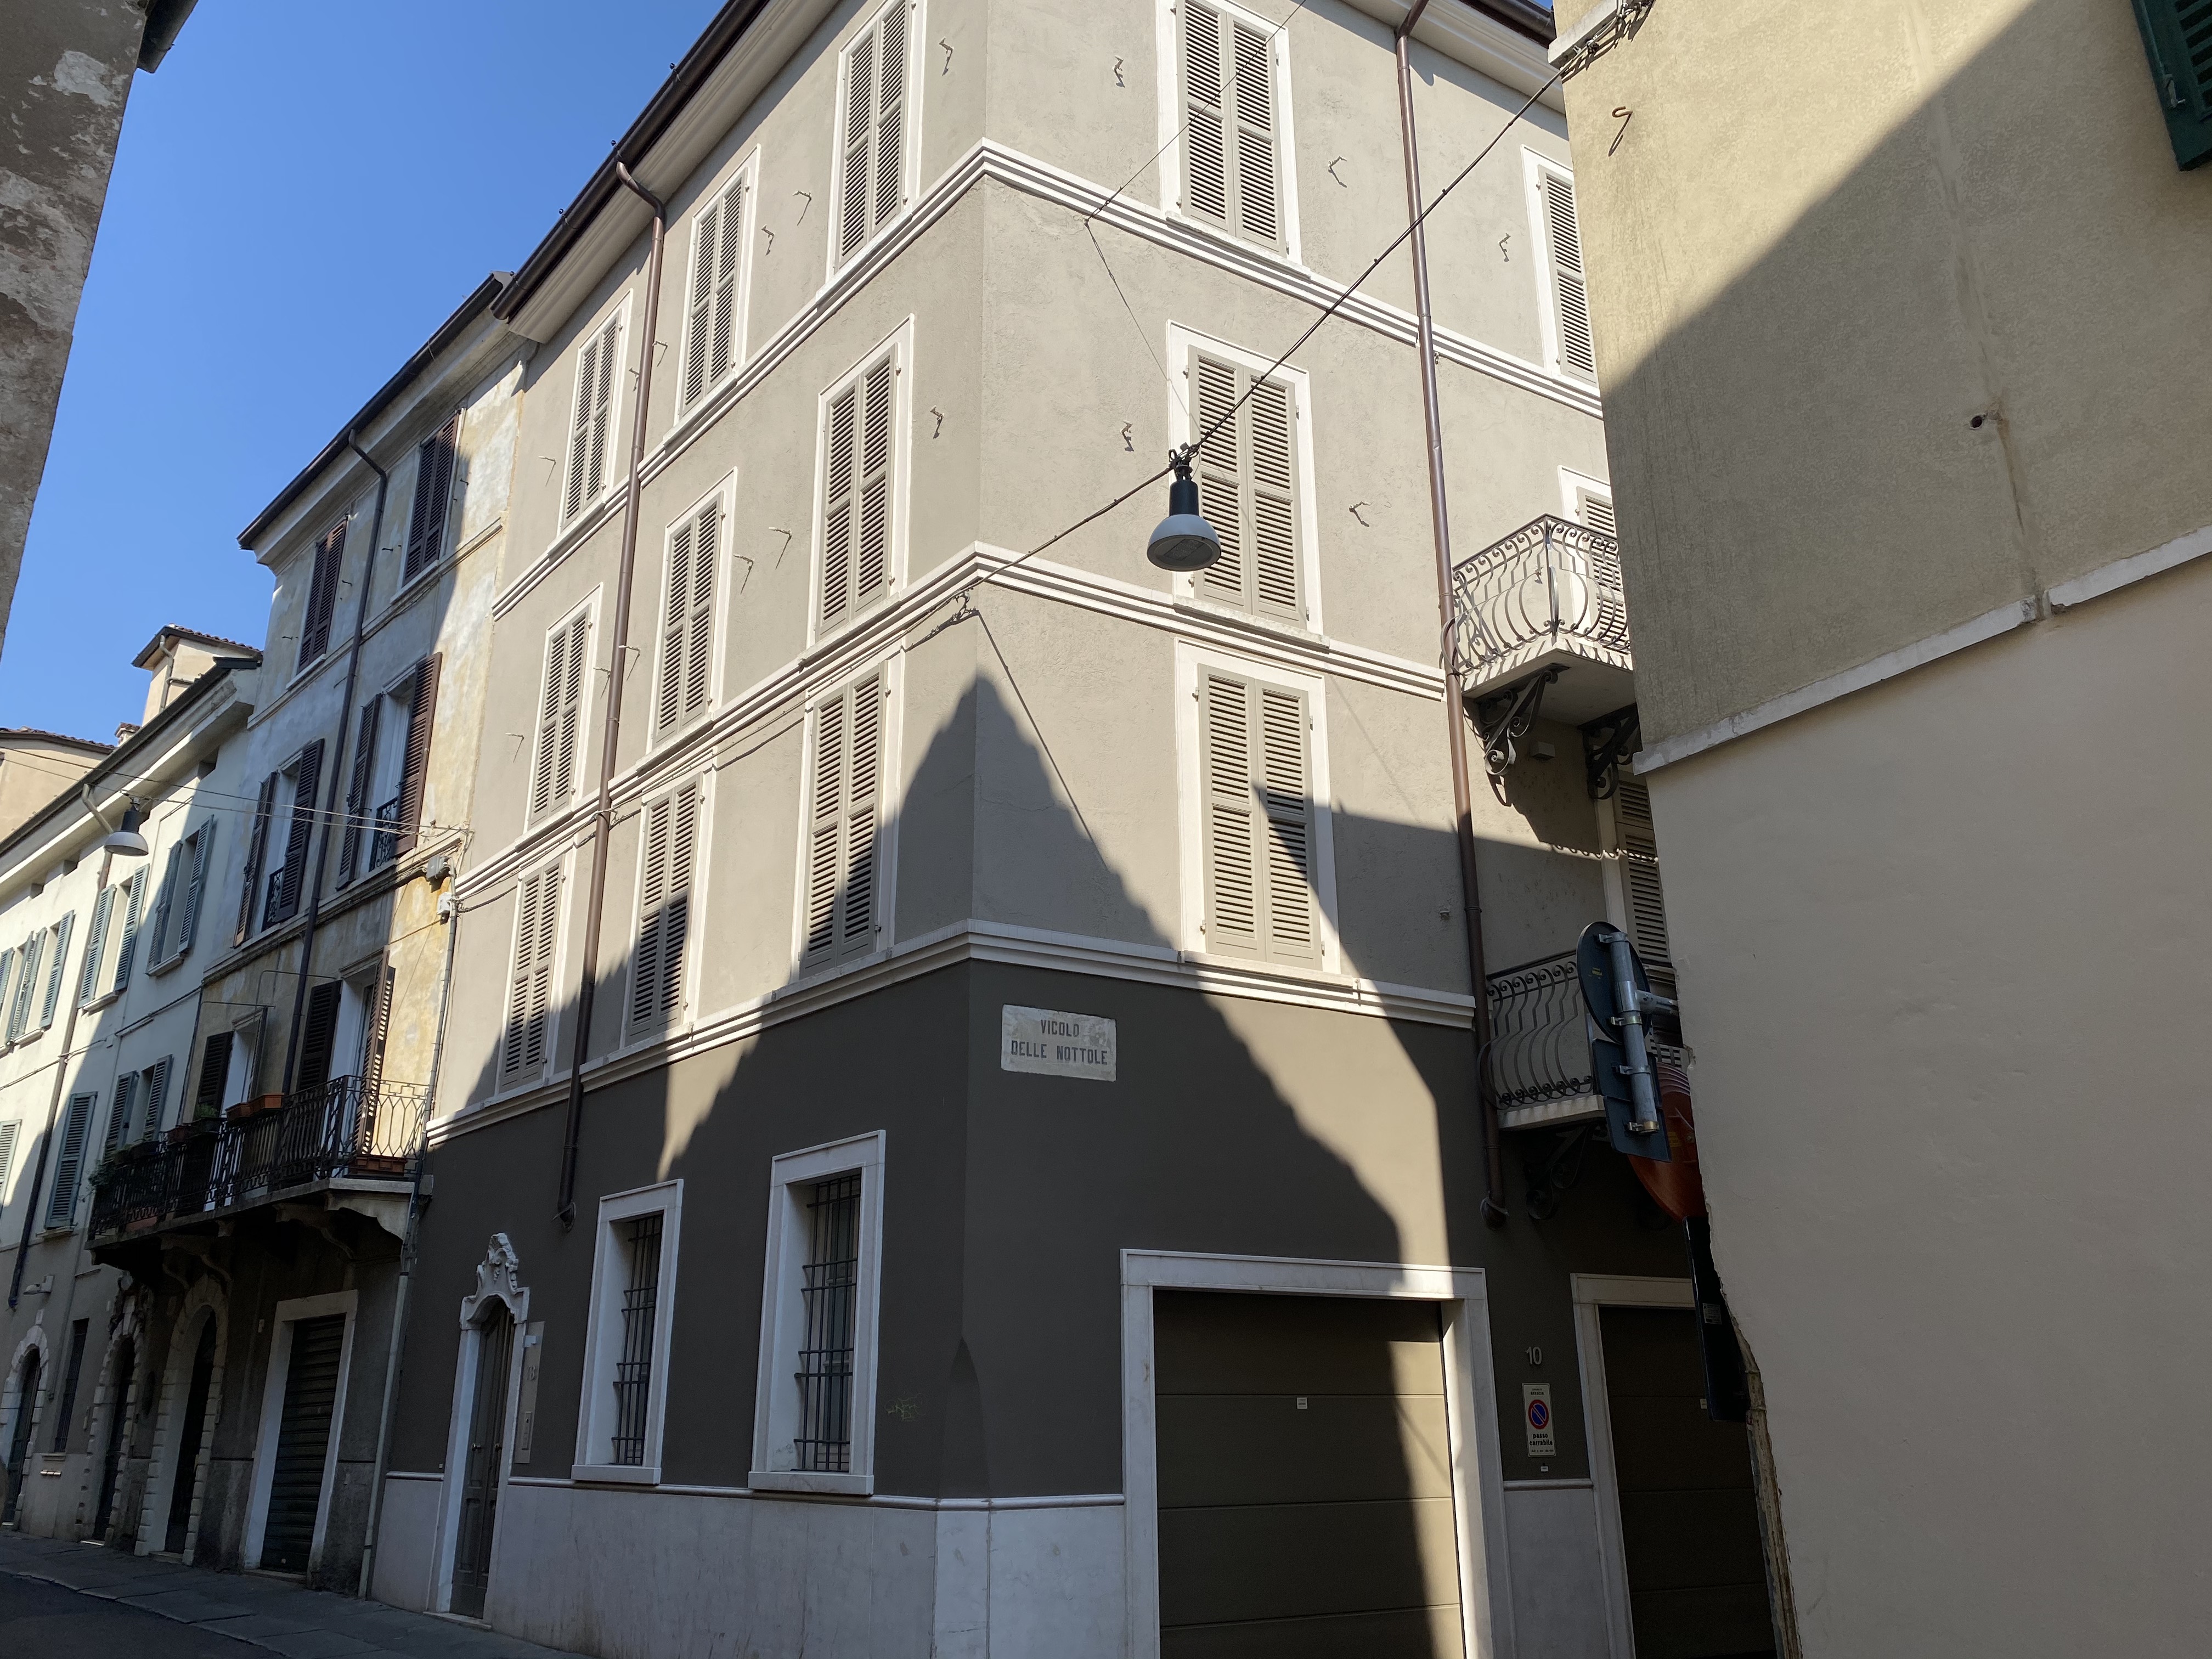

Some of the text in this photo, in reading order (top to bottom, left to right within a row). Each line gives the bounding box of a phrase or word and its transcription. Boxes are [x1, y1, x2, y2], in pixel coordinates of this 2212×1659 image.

[1040, 1019, 1080, 1037] VICOLO
[1011, 1040, 1108, 1065] DELLE NOTTOLE
[1525, 1346, 1542, 1365] 10
